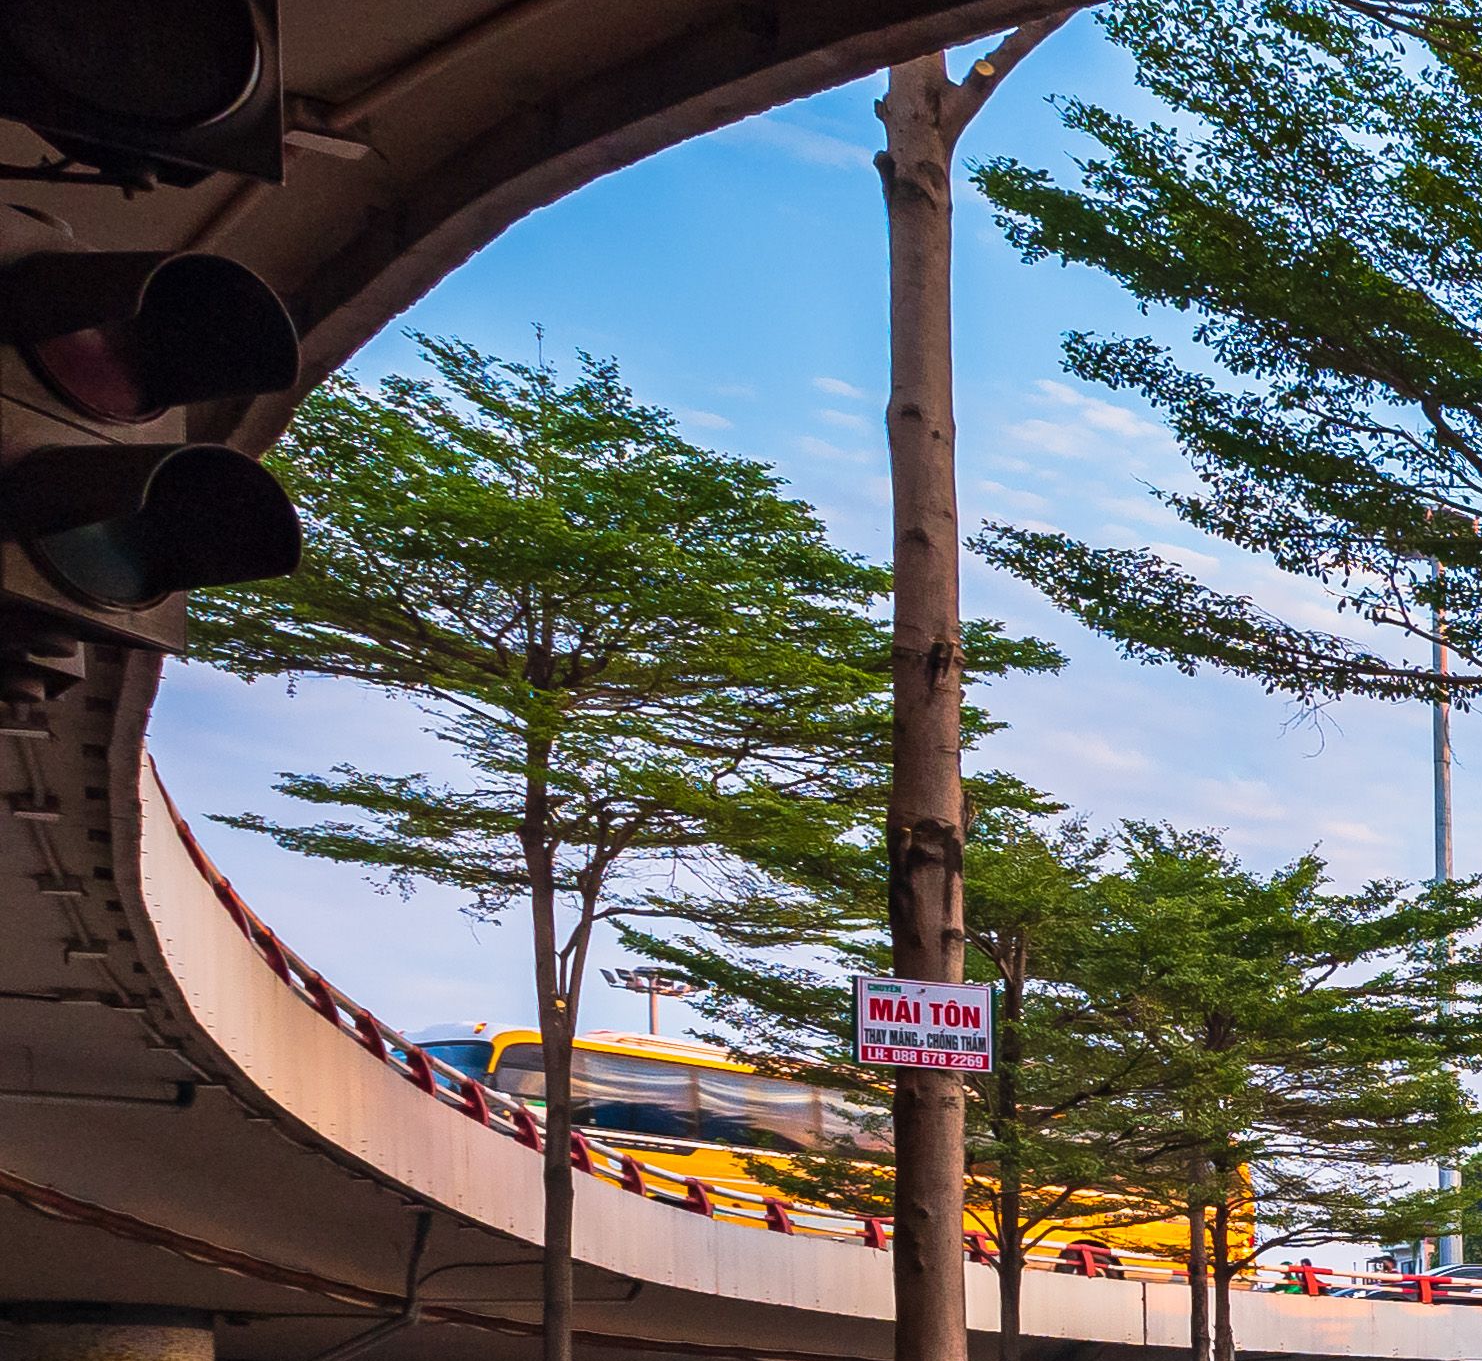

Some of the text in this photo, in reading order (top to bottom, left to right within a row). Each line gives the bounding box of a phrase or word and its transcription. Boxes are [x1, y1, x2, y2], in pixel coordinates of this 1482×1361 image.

[869, 995, 981, 1029] MÁI TÔN
[864, 1028, 887, 1045] THAY
[926, 1029, 959, 1051] CHỐNG
[867, 1047, 984, 1068] LH: 088 678 2269
